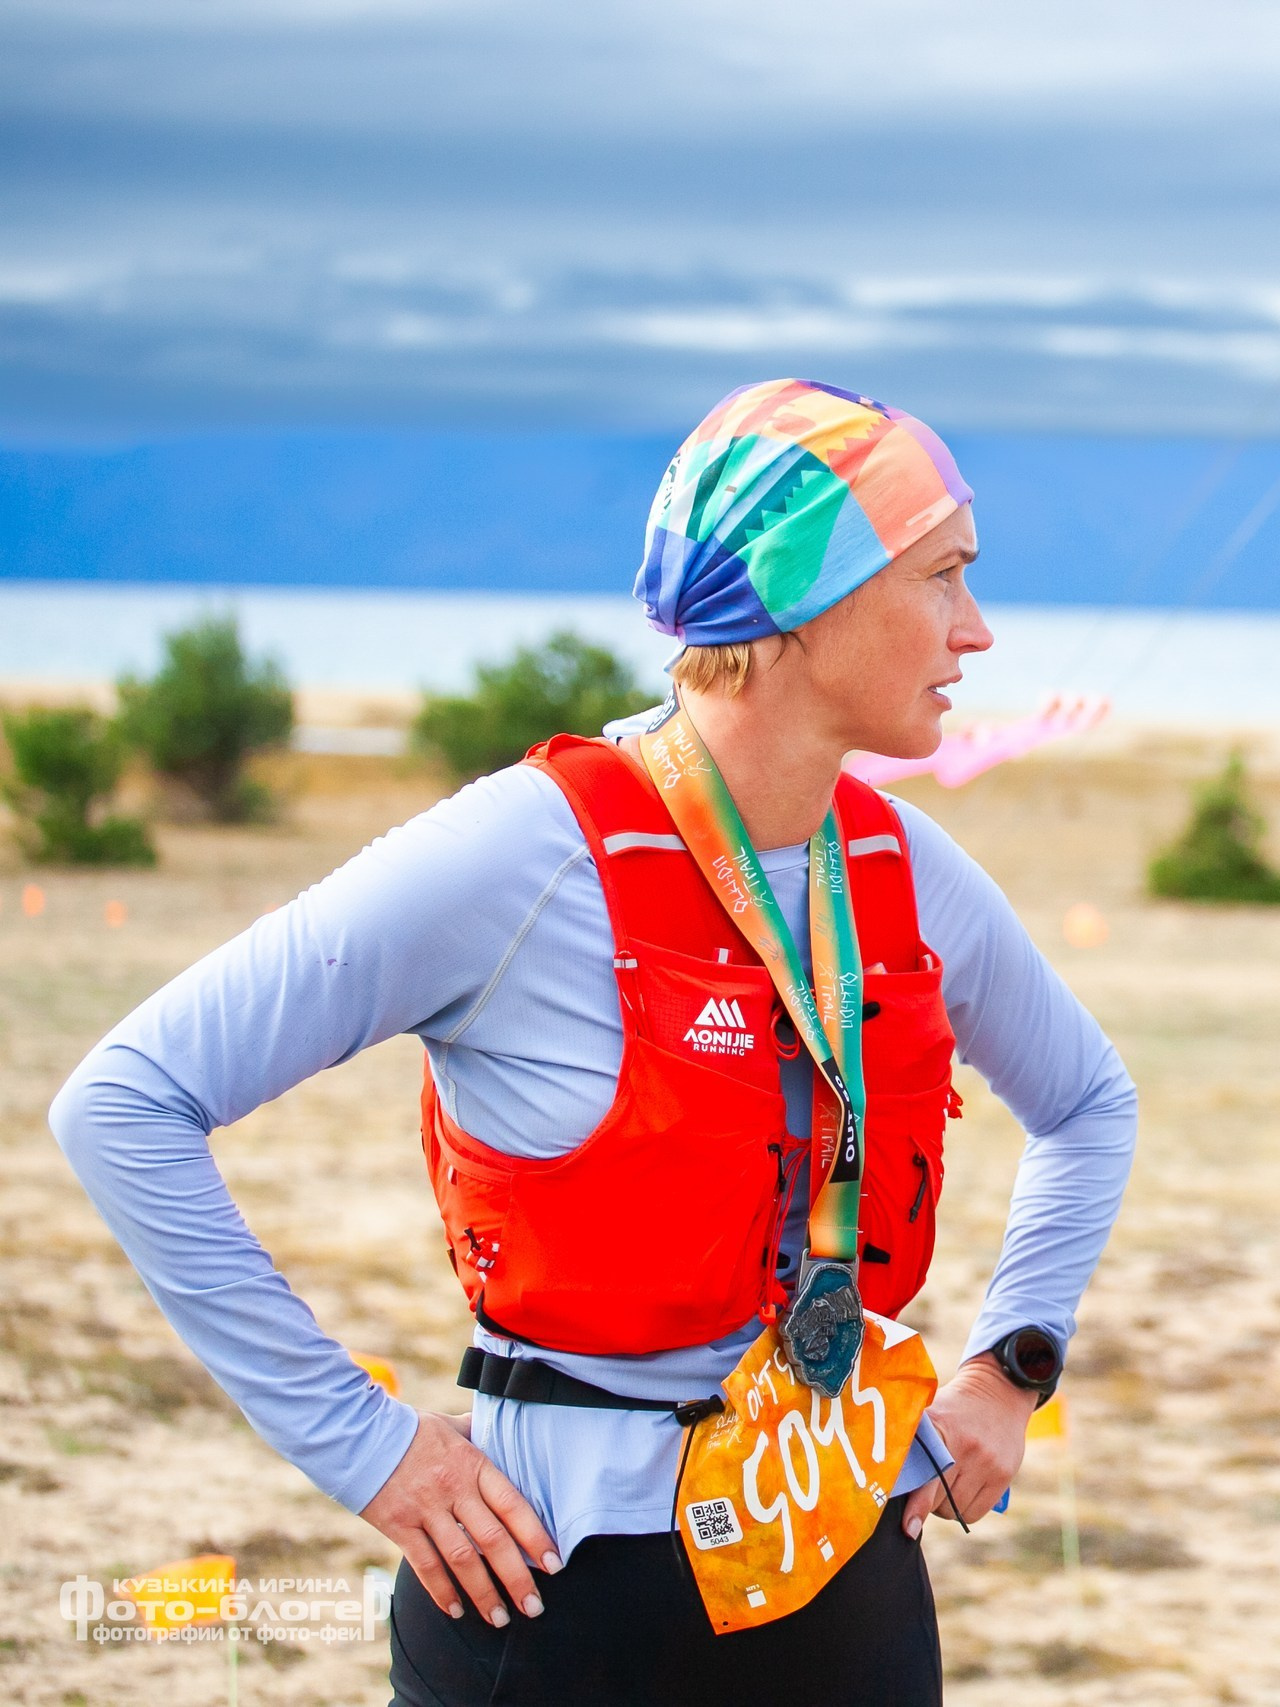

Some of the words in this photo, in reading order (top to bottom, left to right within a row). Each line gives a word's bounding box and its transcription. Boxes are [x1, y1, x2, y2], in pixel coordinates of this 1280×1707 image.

[683, 1029, 754, 1049] AONIJIE
[693, 1044, 745, 1056] RUNNING
[710, 1535, 729, 1546] 5043
